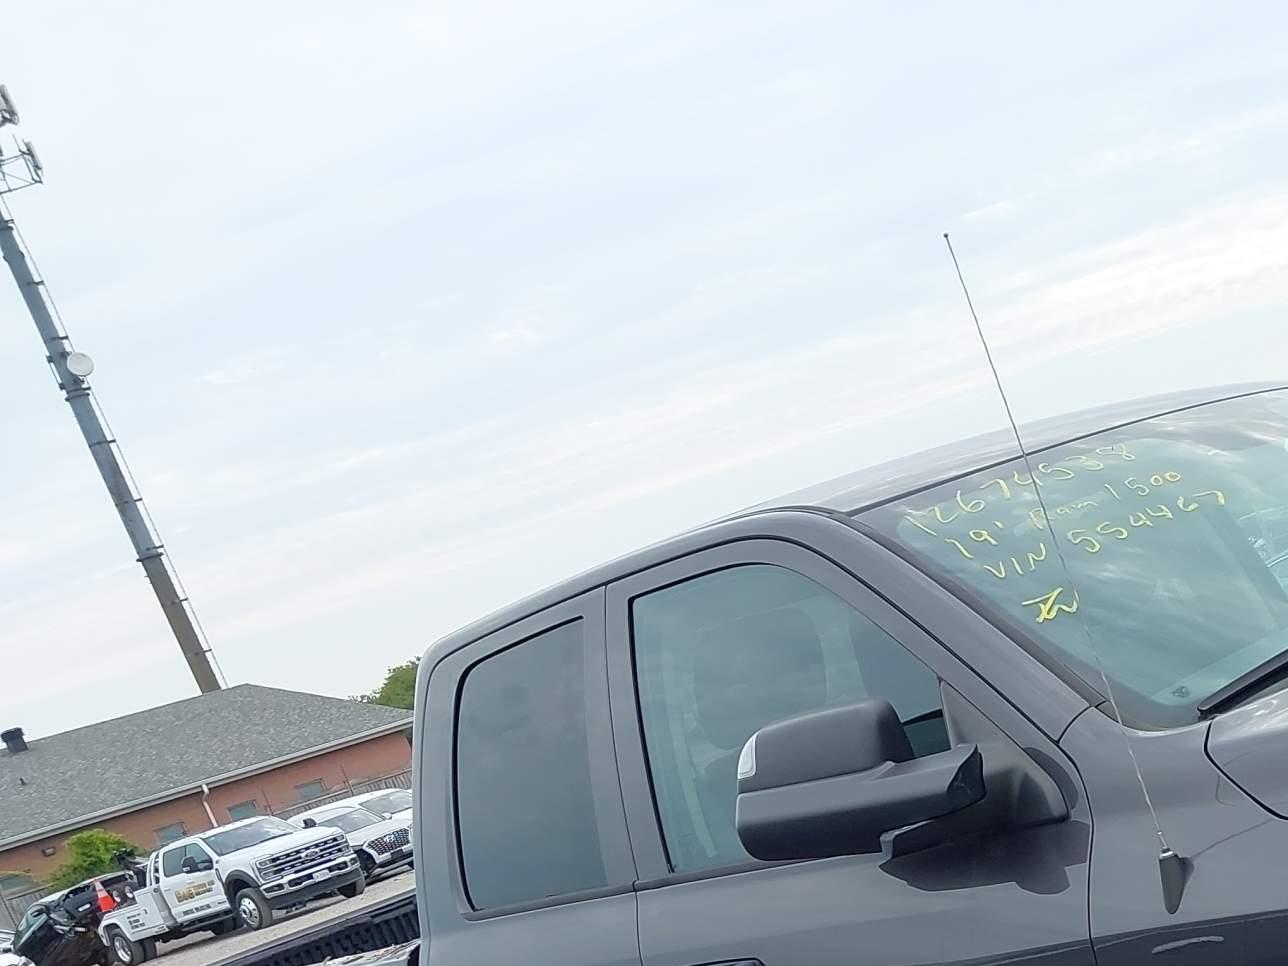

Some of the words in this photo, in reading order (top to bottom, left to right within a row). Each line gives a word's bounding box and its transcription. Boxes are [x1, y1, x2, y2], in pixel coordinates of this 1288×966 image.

[904, 442, 1136, 537] 12674538
[984, 541, 1047, 580] VIN
[1067, 489, 1226, 554] 554467
[1028, 500, 1100, 530] Ram
[1104, 471, 1182, 502] 1500
